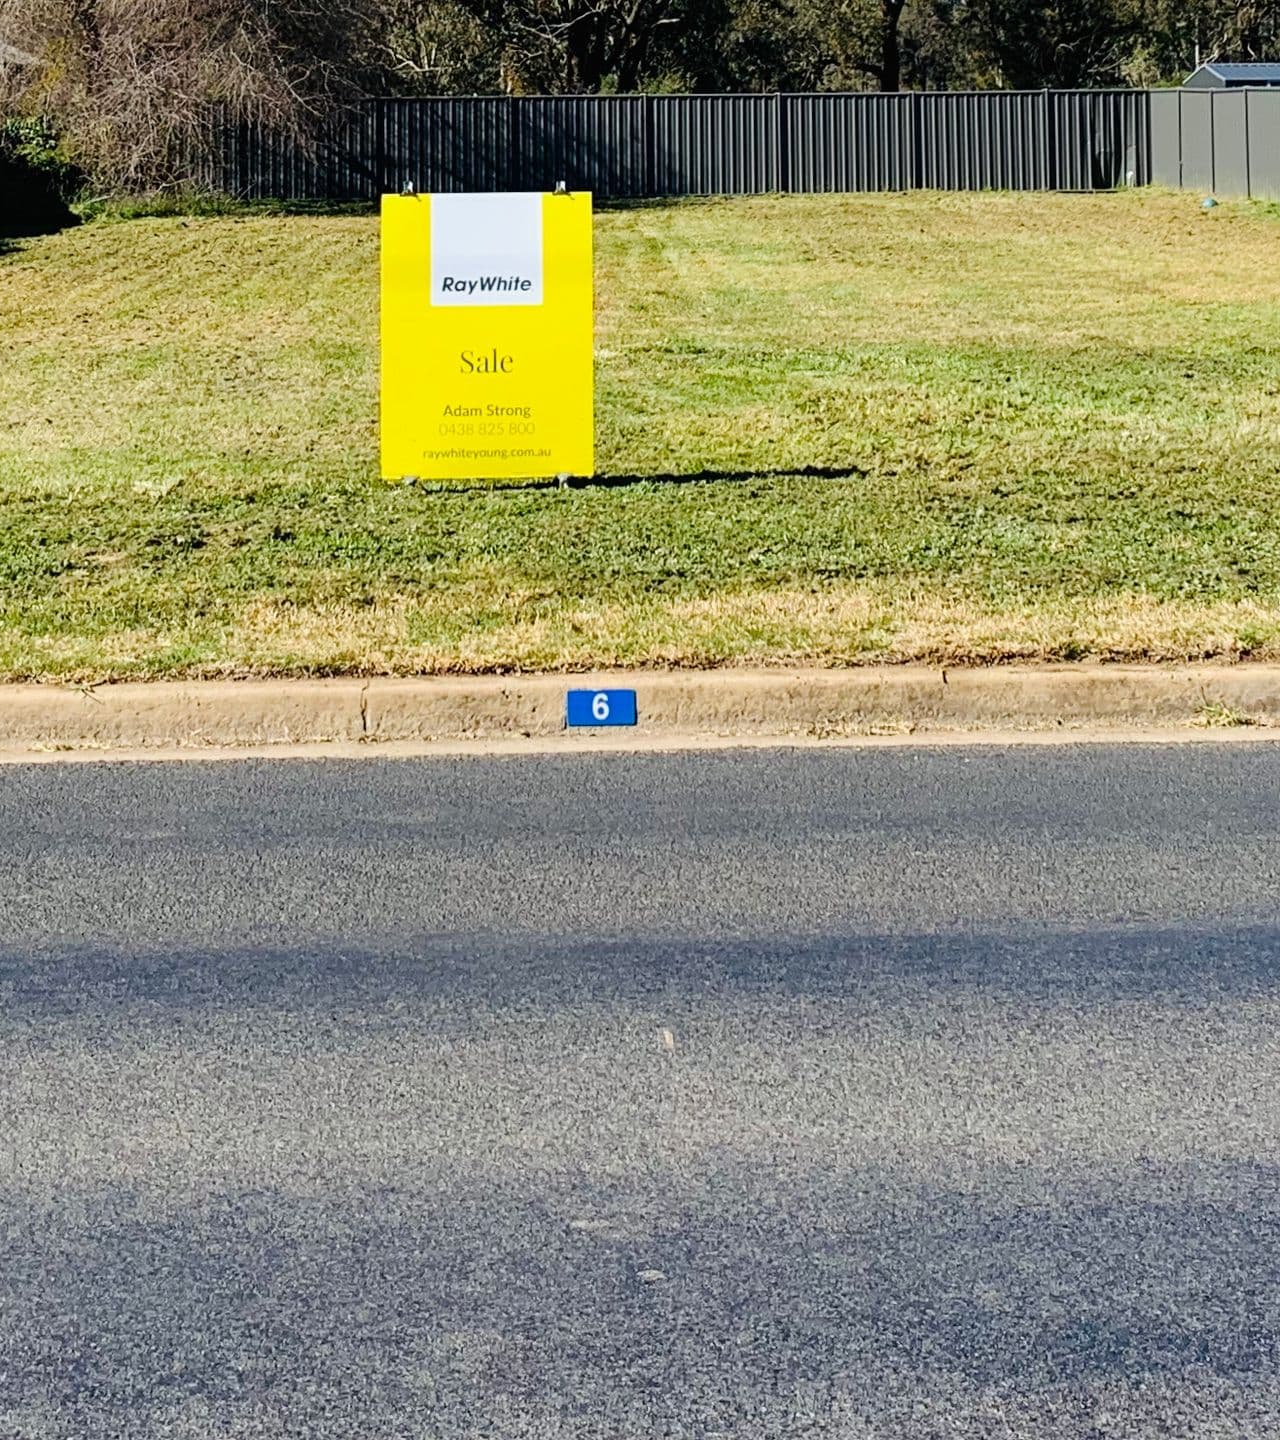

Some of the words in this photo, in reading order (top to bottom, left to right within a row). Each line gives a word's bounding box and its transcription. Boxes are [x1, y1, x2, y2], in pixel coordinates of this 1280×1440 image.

[460, 348, 514, 374] Sale
[443, 404, 482, 417] Adam
[486, 404, 531, 419] Strong
[438, 422, 474, 436] 0438
[478, 422, 504, 436] 825
[509, 422, 535, 436] 800
[423, 446, 552, 460] raywhiteyoung.com.au
[592, 693, 609, 720] 6
